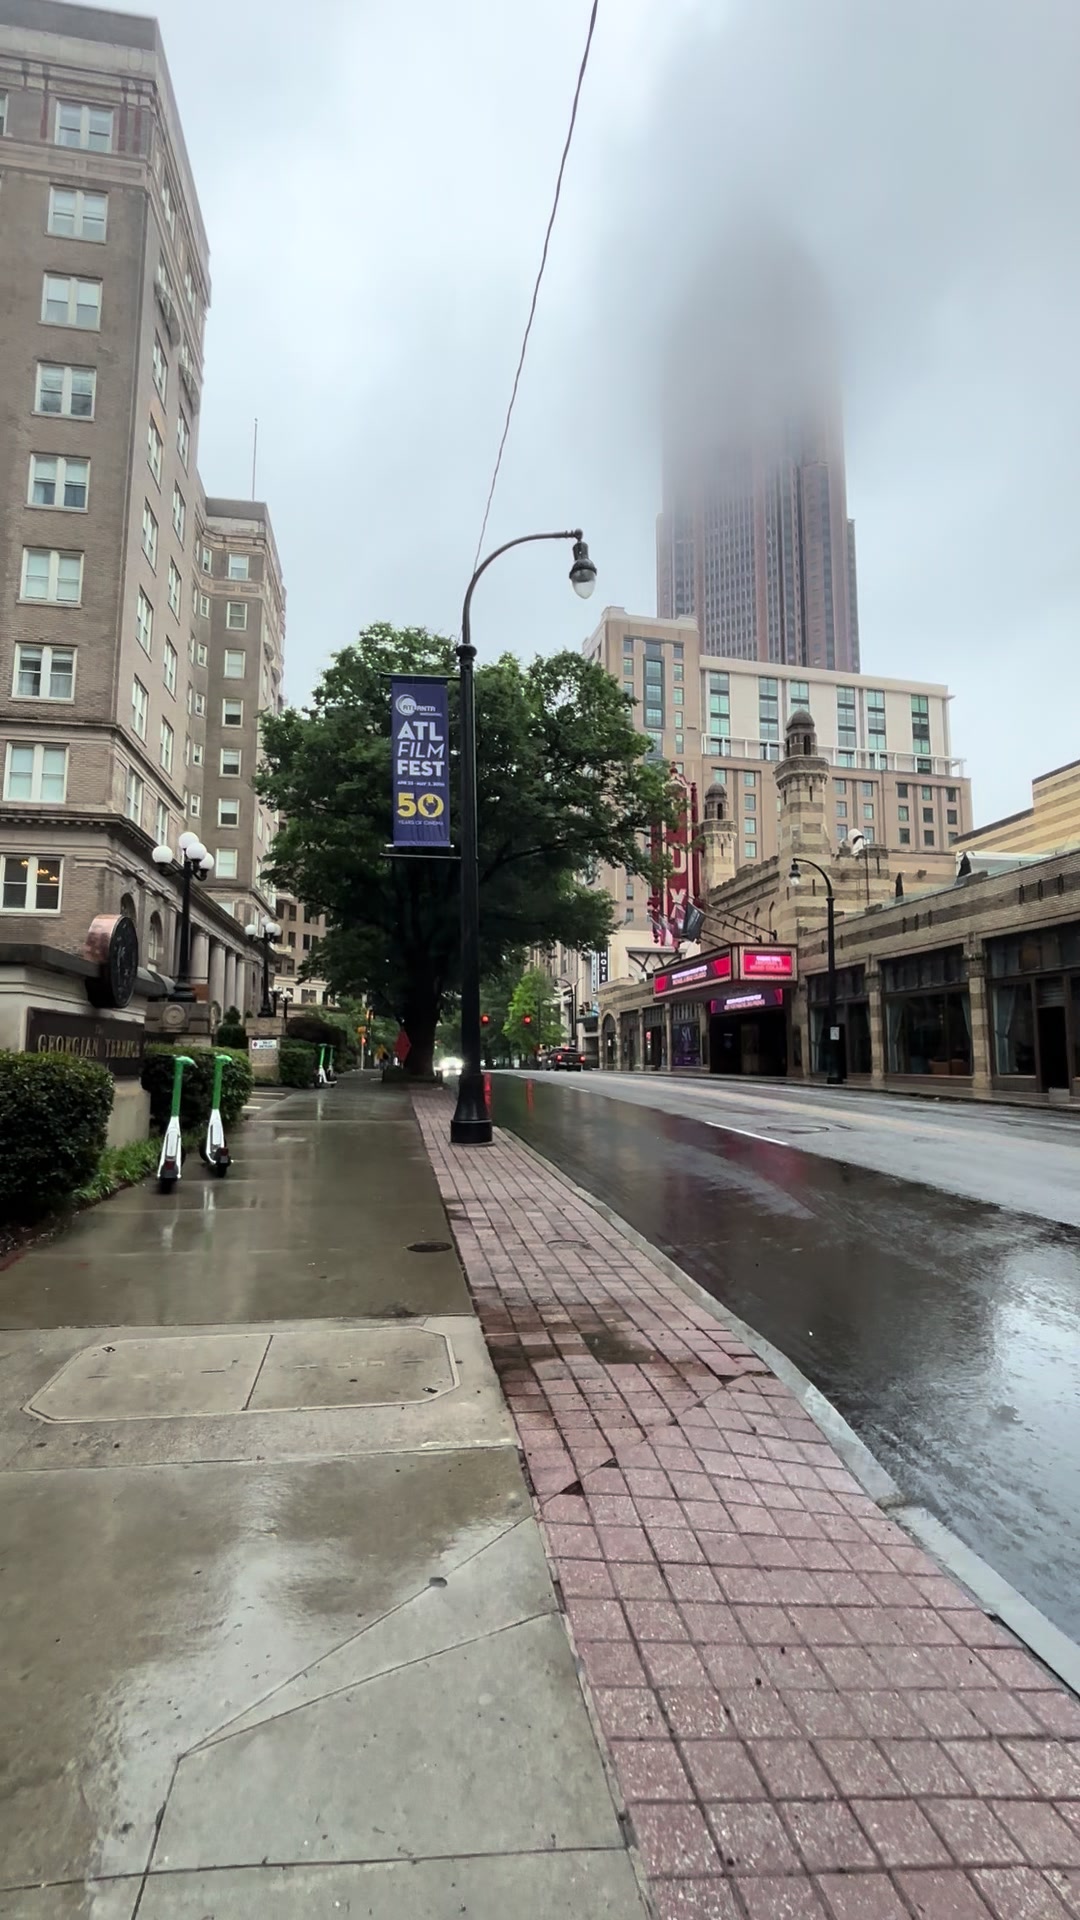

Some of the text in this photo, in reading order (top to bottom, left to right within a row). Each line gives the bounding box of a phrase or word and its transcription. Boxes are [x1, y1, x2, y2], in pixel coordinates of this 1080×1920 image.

[397, 720, 444, 741] ATL
[397, 741, 445, 759] FILM
[397, 759, 445, 777] FEST
[397, 792, 445, 818] 50
[37, 1034, 99, 1057] GEORGIAN
